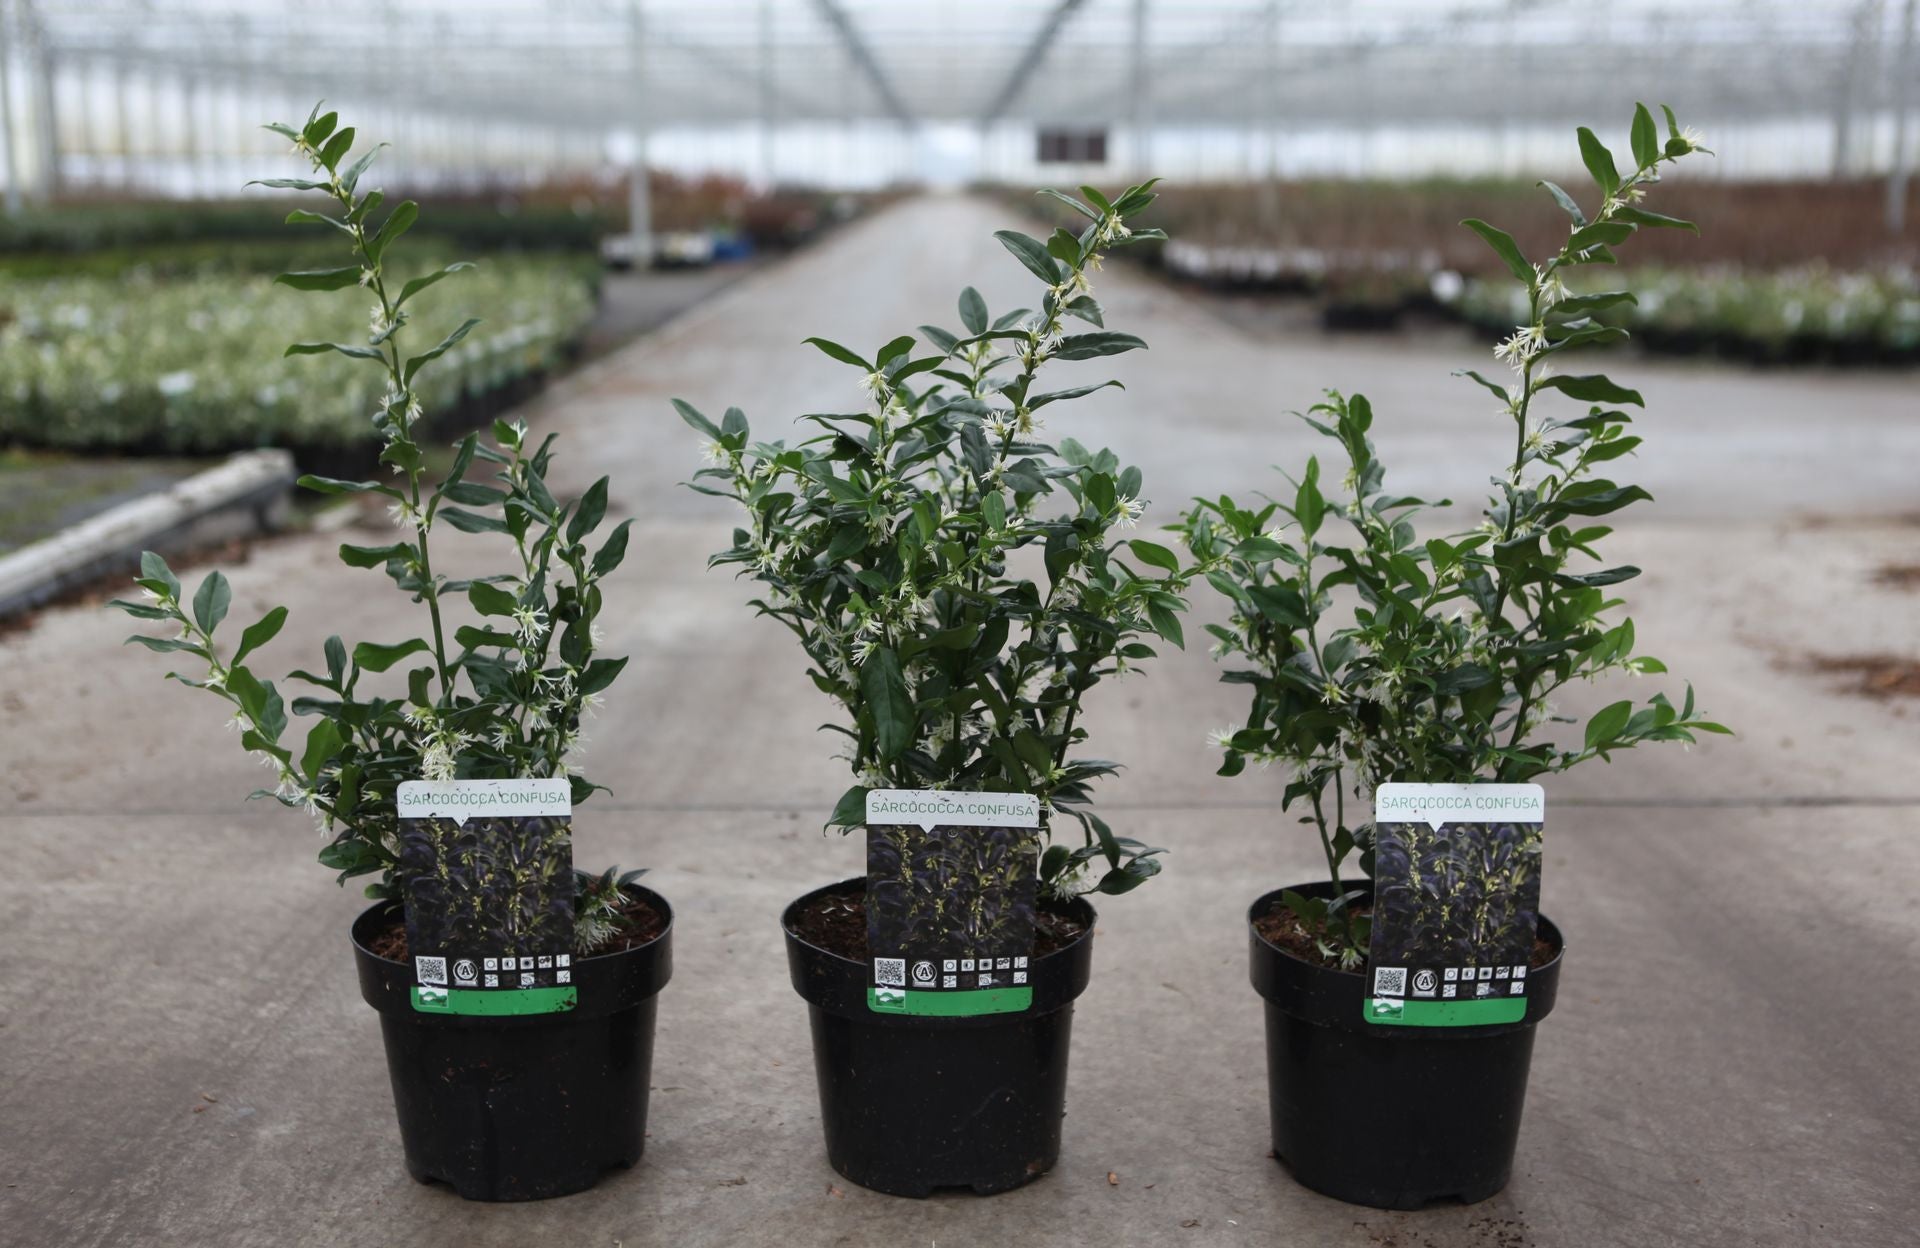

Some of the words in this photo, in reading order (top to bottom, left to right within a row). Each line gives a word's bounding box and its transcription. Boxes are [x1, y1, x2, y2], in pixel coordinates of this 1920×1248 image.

[403, 792, 497, 806] SARCOCOCCA
[499, 792, 567, 804] CONFUSA
[1382, 796, 1472, 809] SARCOCOCCA
[1476, 797, 1539, 809] CONFUSA
[871, 801, 965, 814] SARCOCOCCA
[968, 803, 1034, 817] CONFUSA
